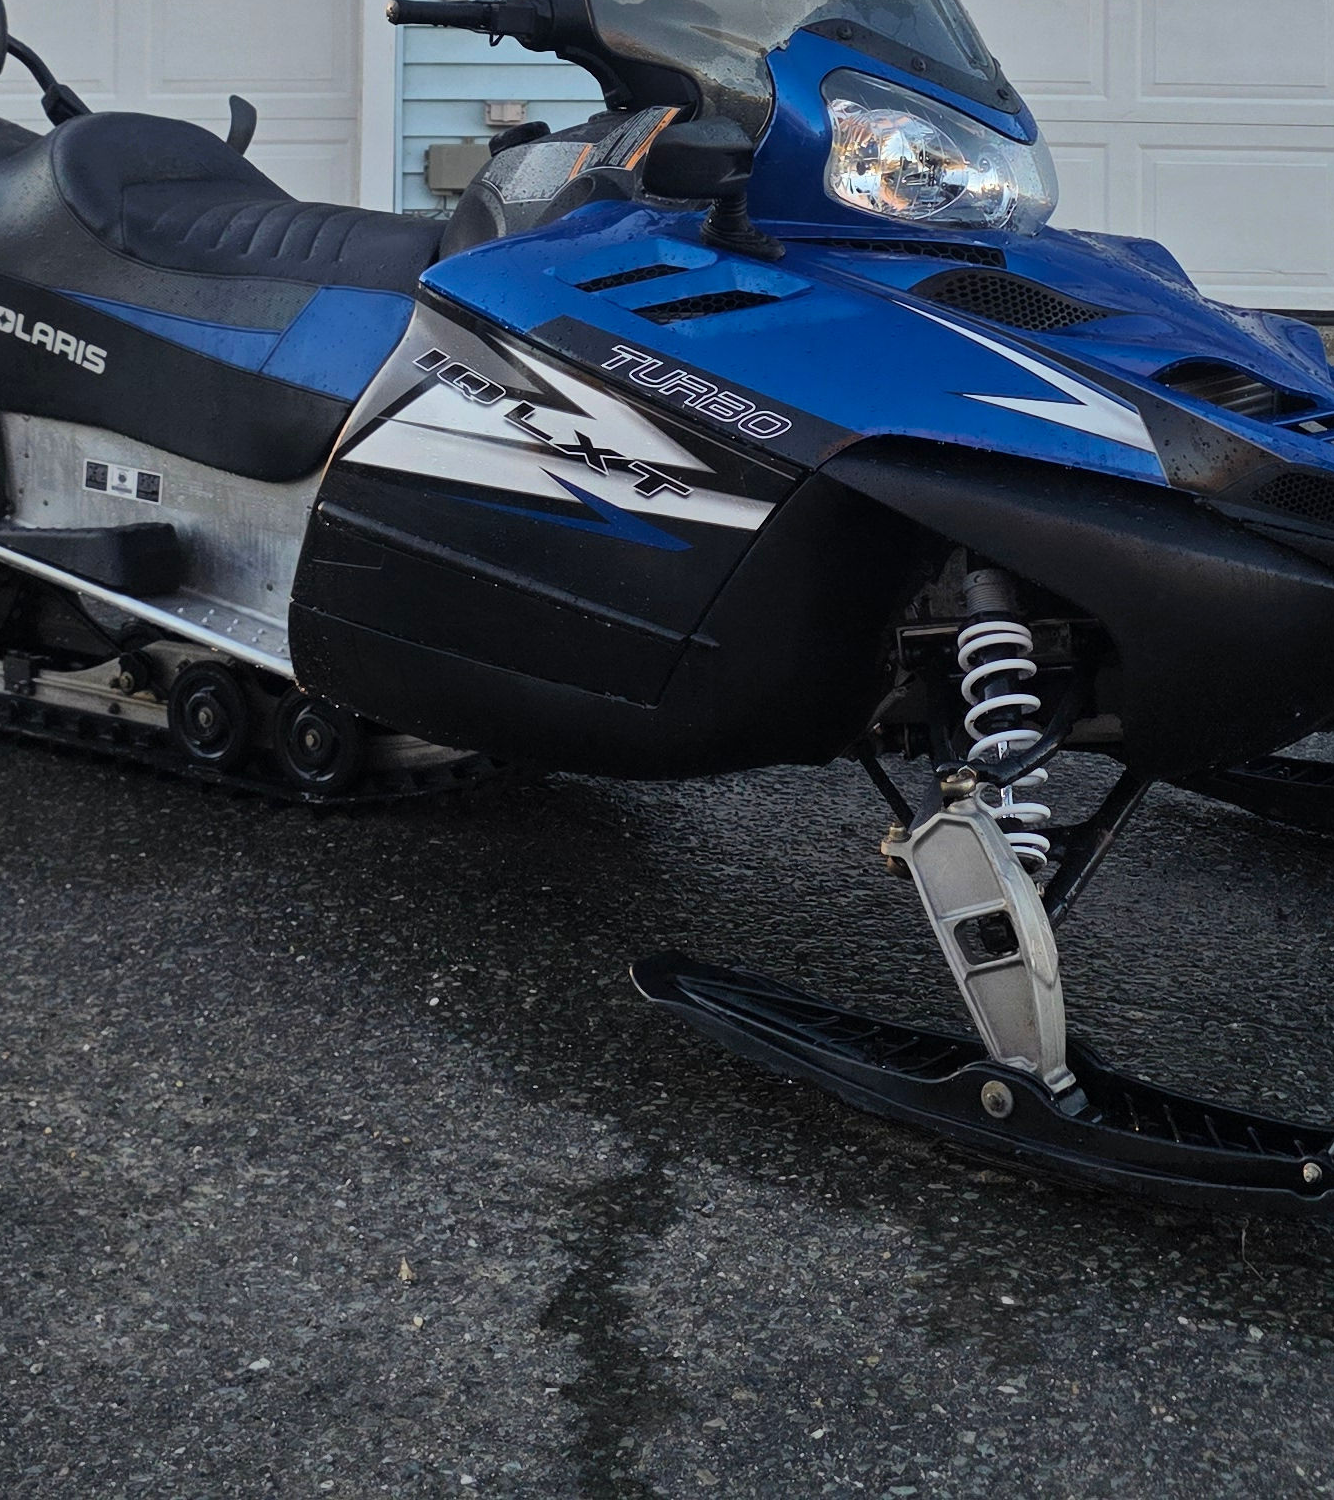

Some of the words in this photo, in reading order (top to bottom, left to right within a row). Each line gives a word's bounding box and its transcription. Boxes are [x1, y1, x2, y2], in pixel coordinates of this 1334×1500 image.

[412, 347, 507, 405] IQ
[503, 399, 695, 498] LXT
[600, 344, 792, 440] TURBO
